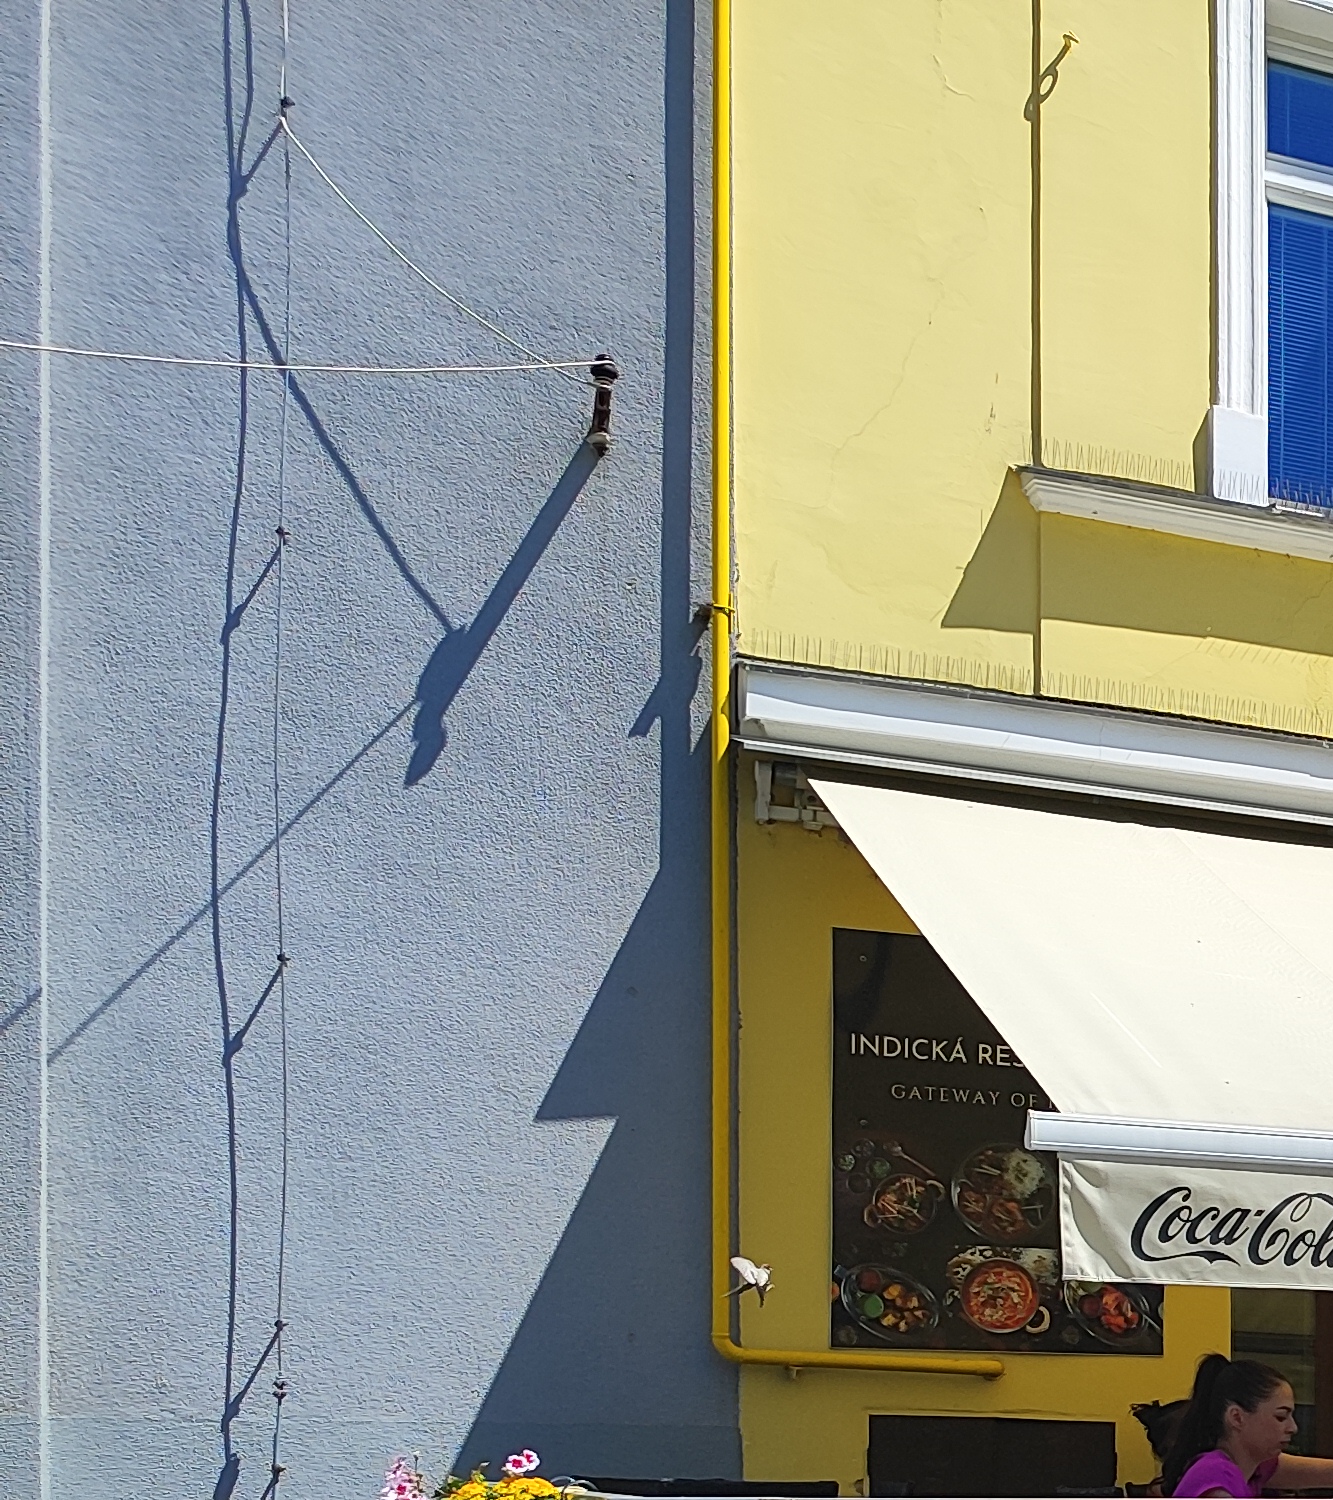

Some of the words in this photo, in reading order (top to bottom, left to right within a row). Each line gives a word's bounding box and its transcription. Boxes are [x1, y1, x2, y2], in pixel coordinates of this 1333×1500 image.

[850, 1032, 968, 1064] INDICKÁ
[891, 1084, 1001, 1107] GATEWAY
[1010, 1092, 1038, 1108] OF
